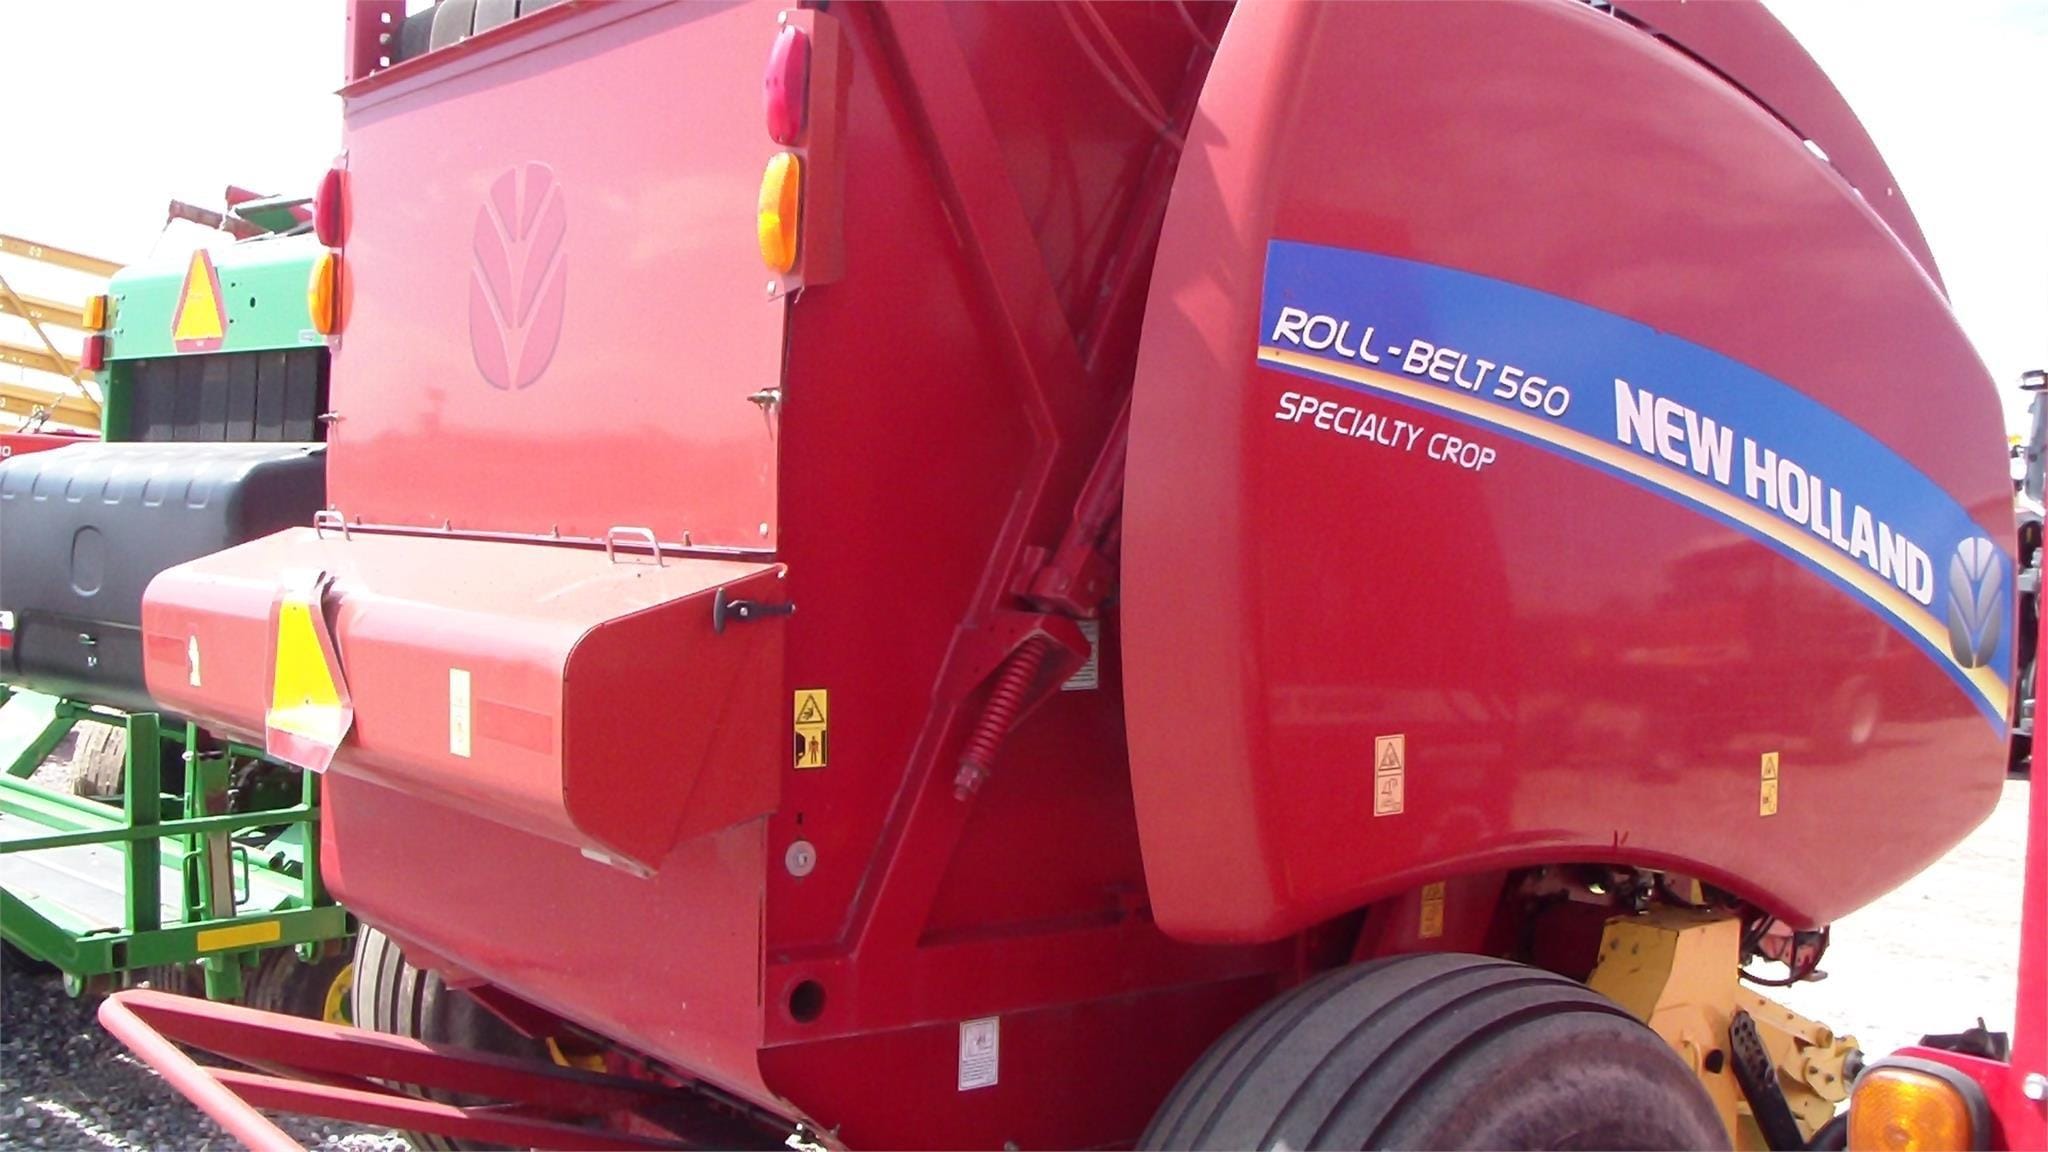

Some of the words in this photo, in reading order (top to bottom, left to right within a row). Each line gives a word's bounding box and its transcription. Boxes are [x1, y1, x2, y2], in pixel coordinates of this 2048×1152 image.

[1274, 391, 1425, 452] SPECIALTY
[1427, 432, 1497, 472] CROP
[1493, 364, 1571, 418] 560
[1614, 377, 1734, 486] NEW
[1743, 437, 1934, 606] HOLLAND
